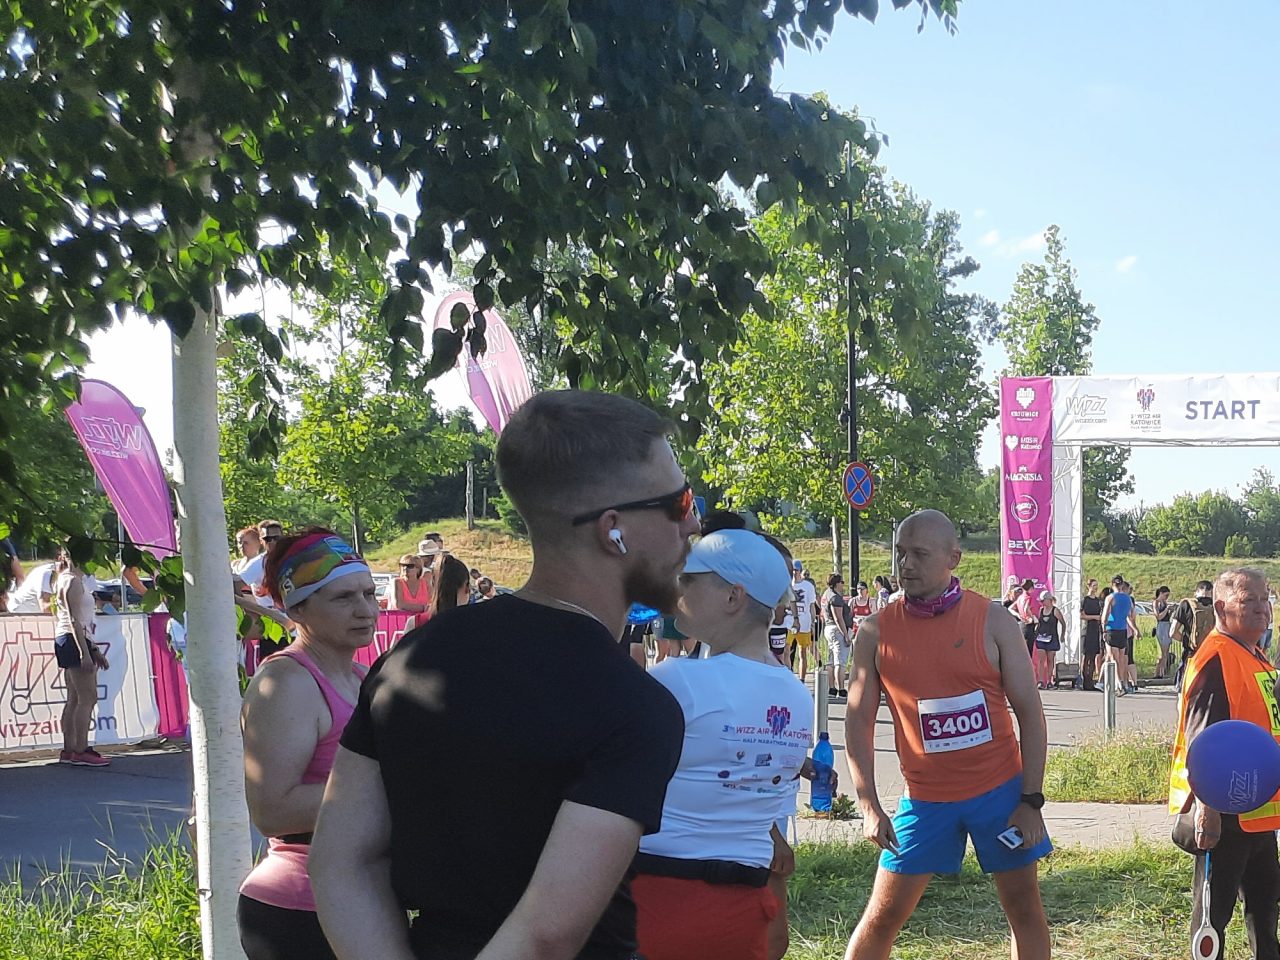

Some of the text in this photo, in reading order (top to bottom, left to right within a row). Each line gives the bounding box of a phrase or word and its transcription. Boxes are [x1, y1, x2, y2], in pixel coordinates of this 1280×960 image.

[1185, 399, 1261, 420] START
[1004, 472, 1043, 481] MAGNESIA
[928, 711, 983, 737] 3400
[736, 726, 756, 735] WIZZ
[756, 727, 769, 735] AIR
[757, 738, 787, 747] MARATHON
